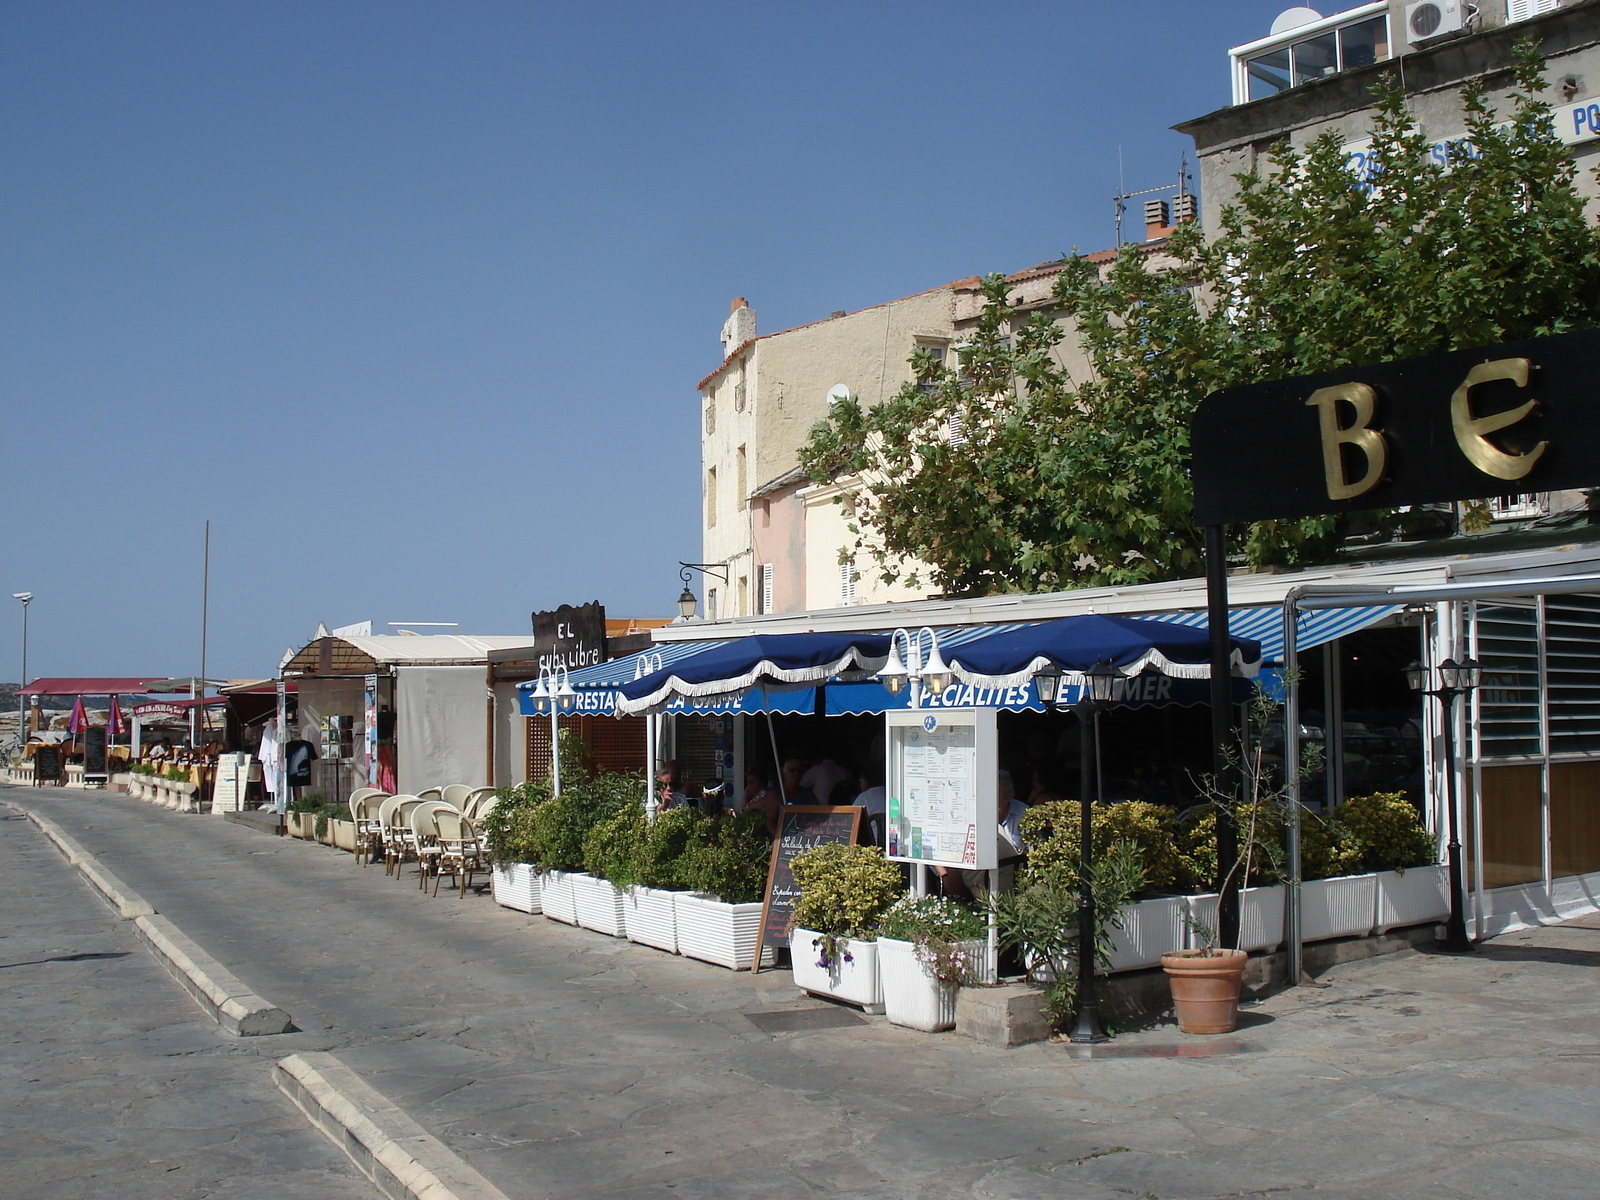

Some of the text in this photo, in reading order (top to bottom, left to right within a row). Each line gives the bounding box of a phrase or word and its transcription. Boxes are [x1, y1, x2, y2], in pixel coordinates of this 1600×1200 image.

[557, 622, 575, 639] EL
[569, 640, 599, 667] Libre
[1121, 676, 1172, 701] MER
[576, 691, 619, 709] RESTA
